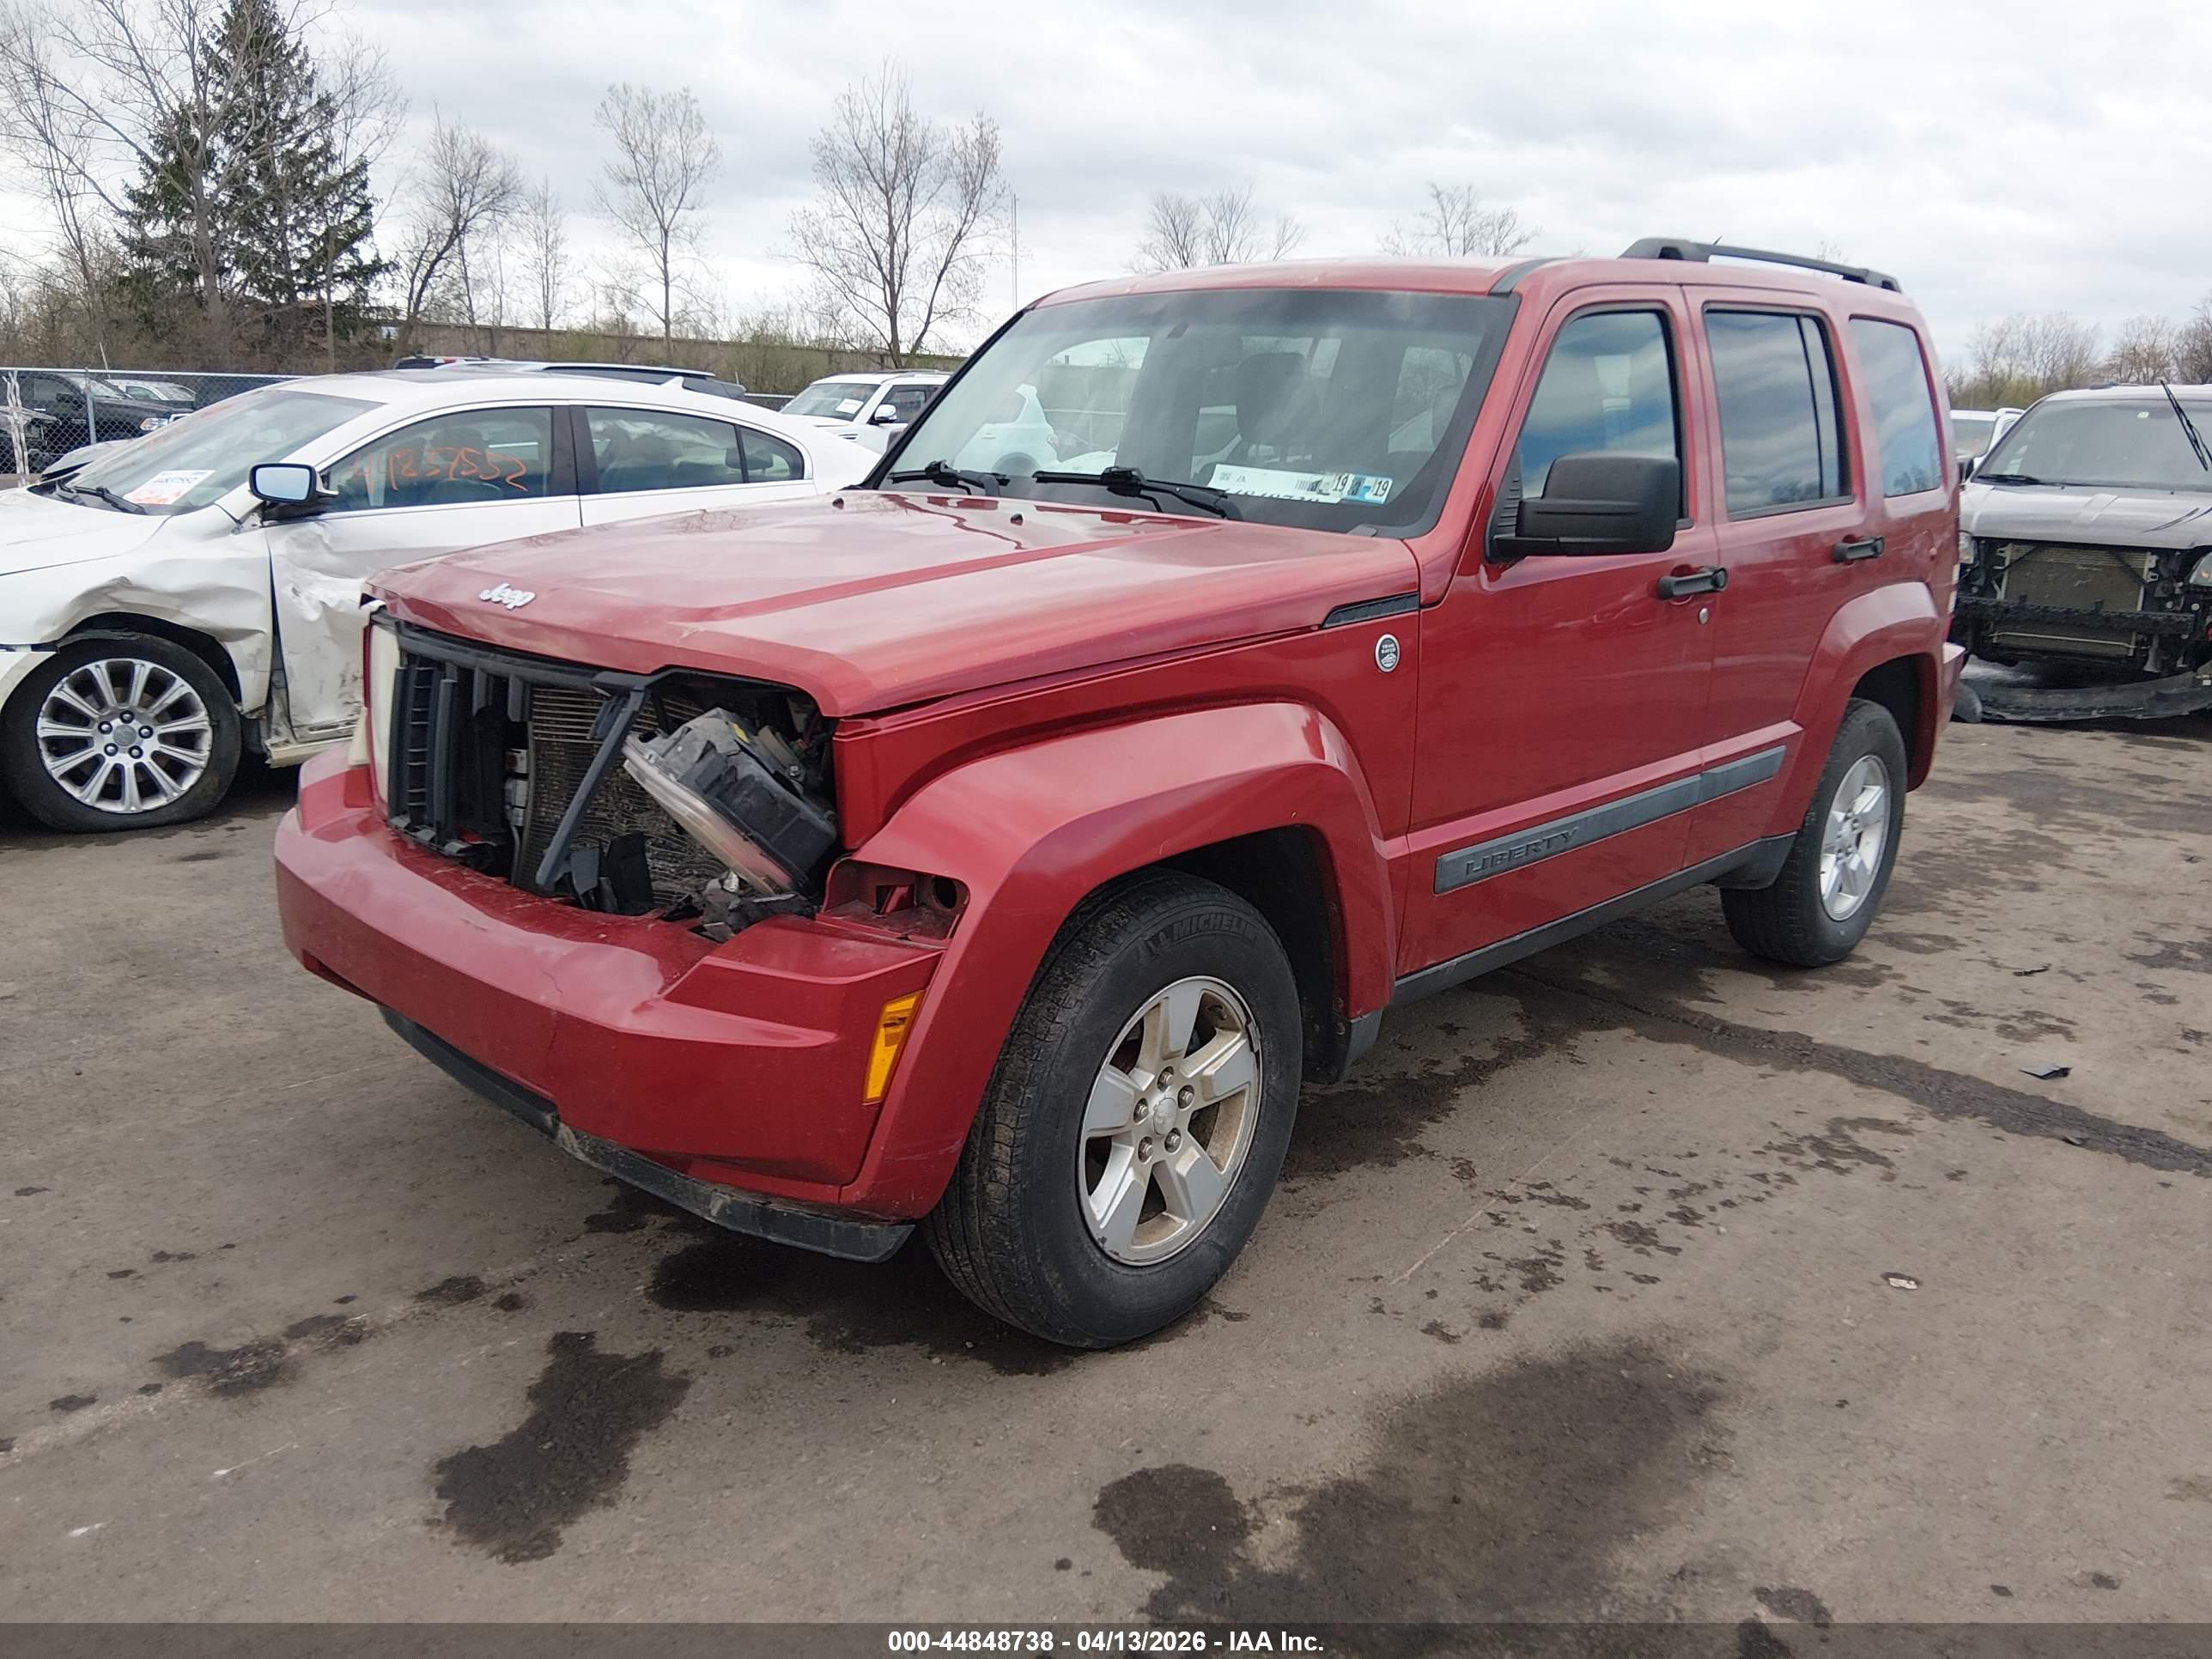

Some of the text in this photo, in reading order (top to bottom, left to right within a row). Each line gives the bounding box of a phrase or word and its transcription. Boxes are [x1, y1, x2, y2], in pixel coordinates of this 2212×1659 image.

[1333, 474, 1349, 492] 19
[1374, 480, 1389, 497] 19
[479, 582, 537, 611] Jeep
[1465, 826, 1579, 876] LIBERTY
[1172, 913, 1258, 942] MICHELIN
